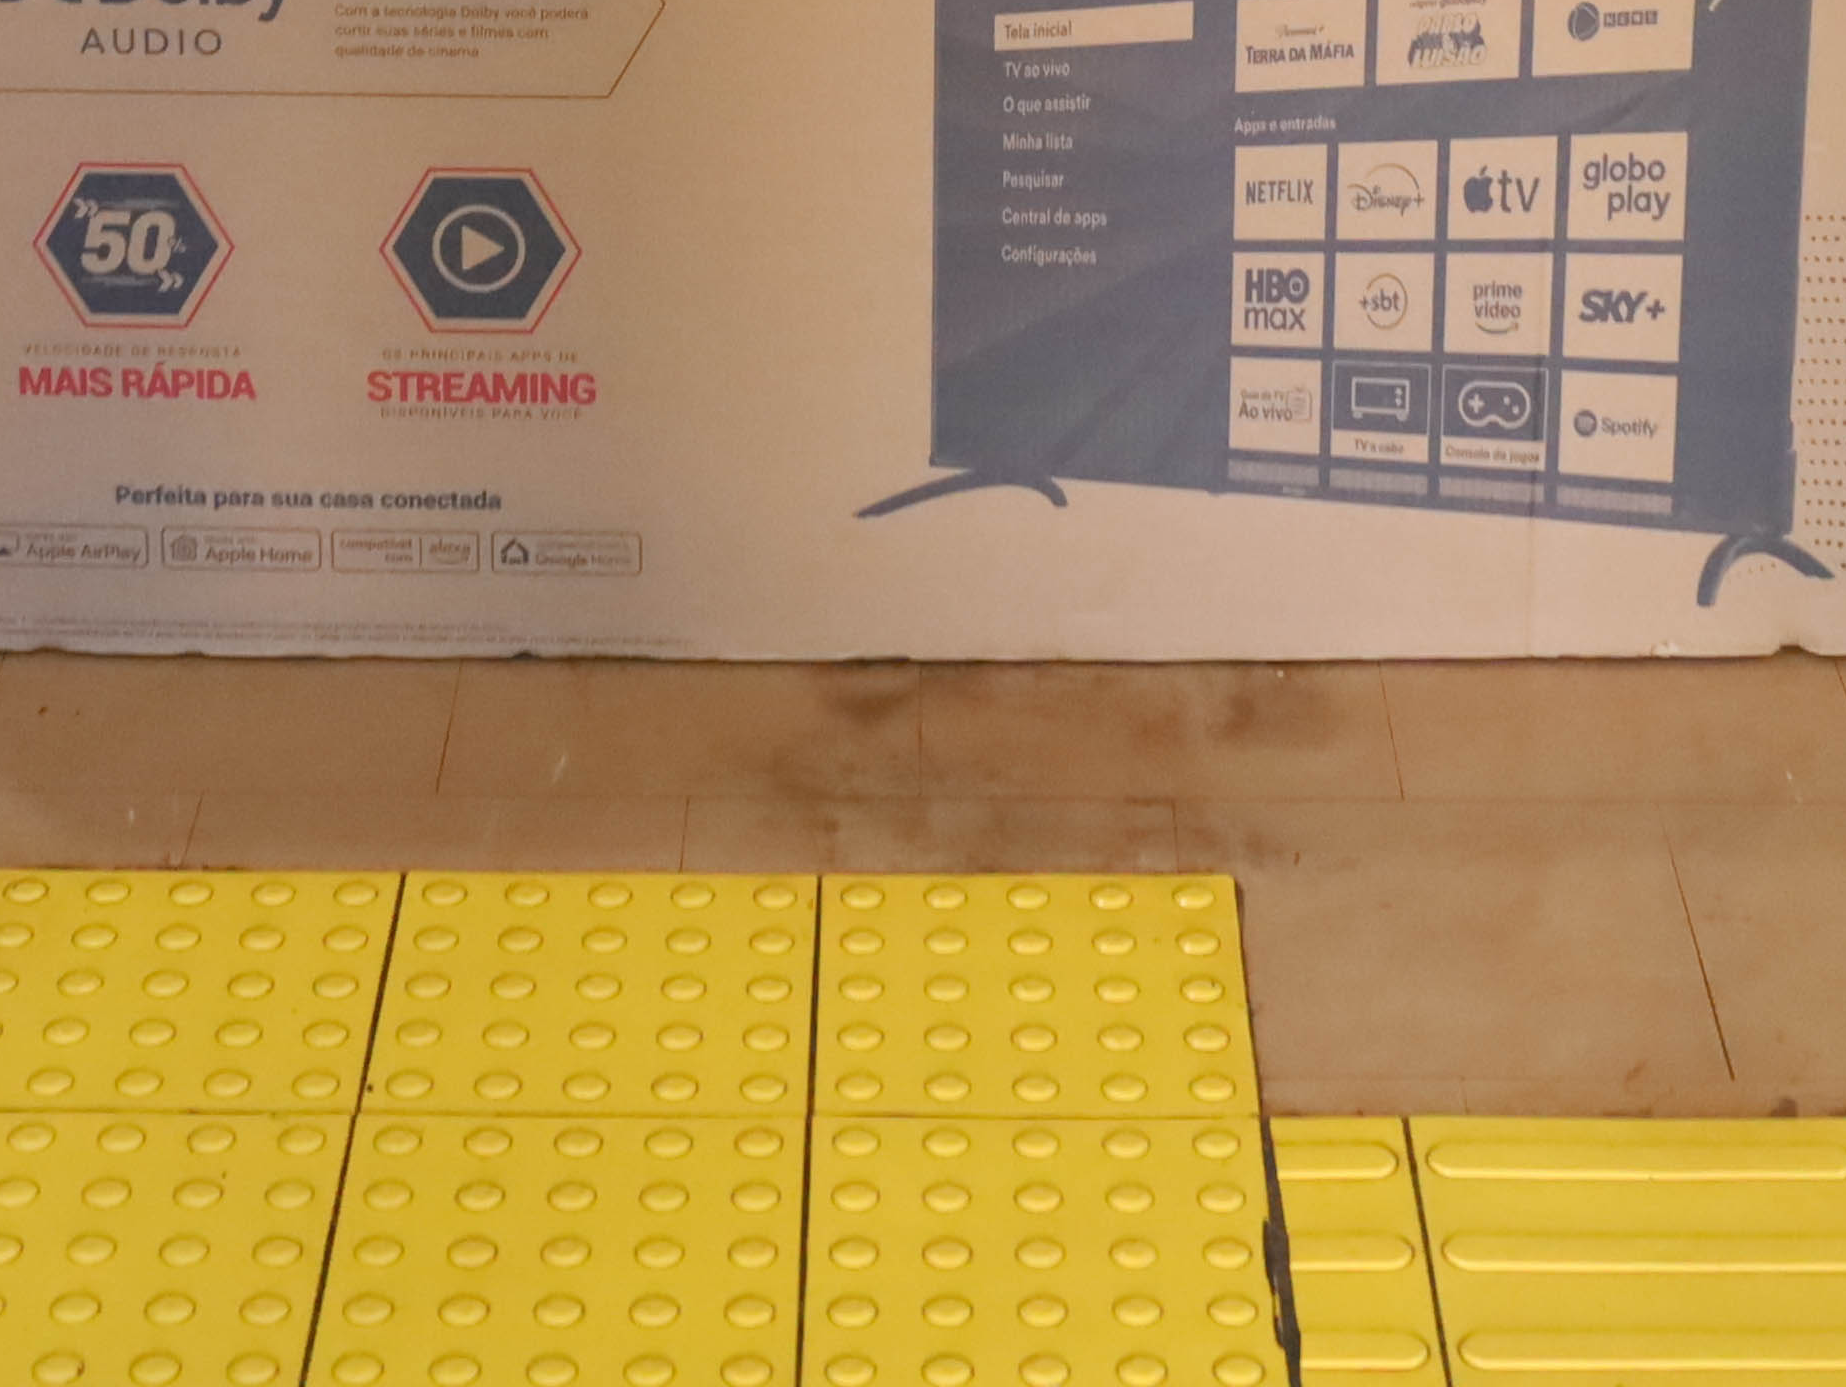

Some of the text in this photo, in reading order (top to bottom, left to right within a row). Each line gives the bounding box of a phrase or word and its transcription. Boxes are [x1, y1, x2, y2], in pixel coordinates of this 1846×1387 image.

[461, 5, 500, 21] Dolby
[1004, 19, 1072, 41] Tela inicial
[81, 28, 222, 56] AUDIO
[1005, 59, 1070, 78] TV ao vivo
[1003, 94, 1091, 115] O que assistir
[1234, 117, 1266, 135] Apps
[1279, 115, 1336, 131] entradas
[1003, 133, 1073, 151] Minha lista
[1003, 170, 1064, 191] Pesquisar
[1582, 152, 1666, 190] globo
[1246, 179, 1313, 205] NETFLIX
[1498, 169, 1540, 213] tv
[1607, 184, 1671, 220] play
[1002, 207, 1107, 230] Central de apps
[1001, 245, 1097, 267] Configurações
[1244, 268, 1310, 304] HBO
[1472, 280, 1522, 302] prime
[1244, 306, 1306, 331] max
[1475, 301, 1521, 319] video
[19, 361, 257, 400] MAIS RÁPIDA
[367, 370, 597, 405] STREAMING
[1239, 402, 1293, 421] Ao vivo
[1601, 416, 1658, 438] Spotify
[1355, 438, 1368, 452] TV
[114, 485, 502, 512] Perfeita para sua casa conectada
